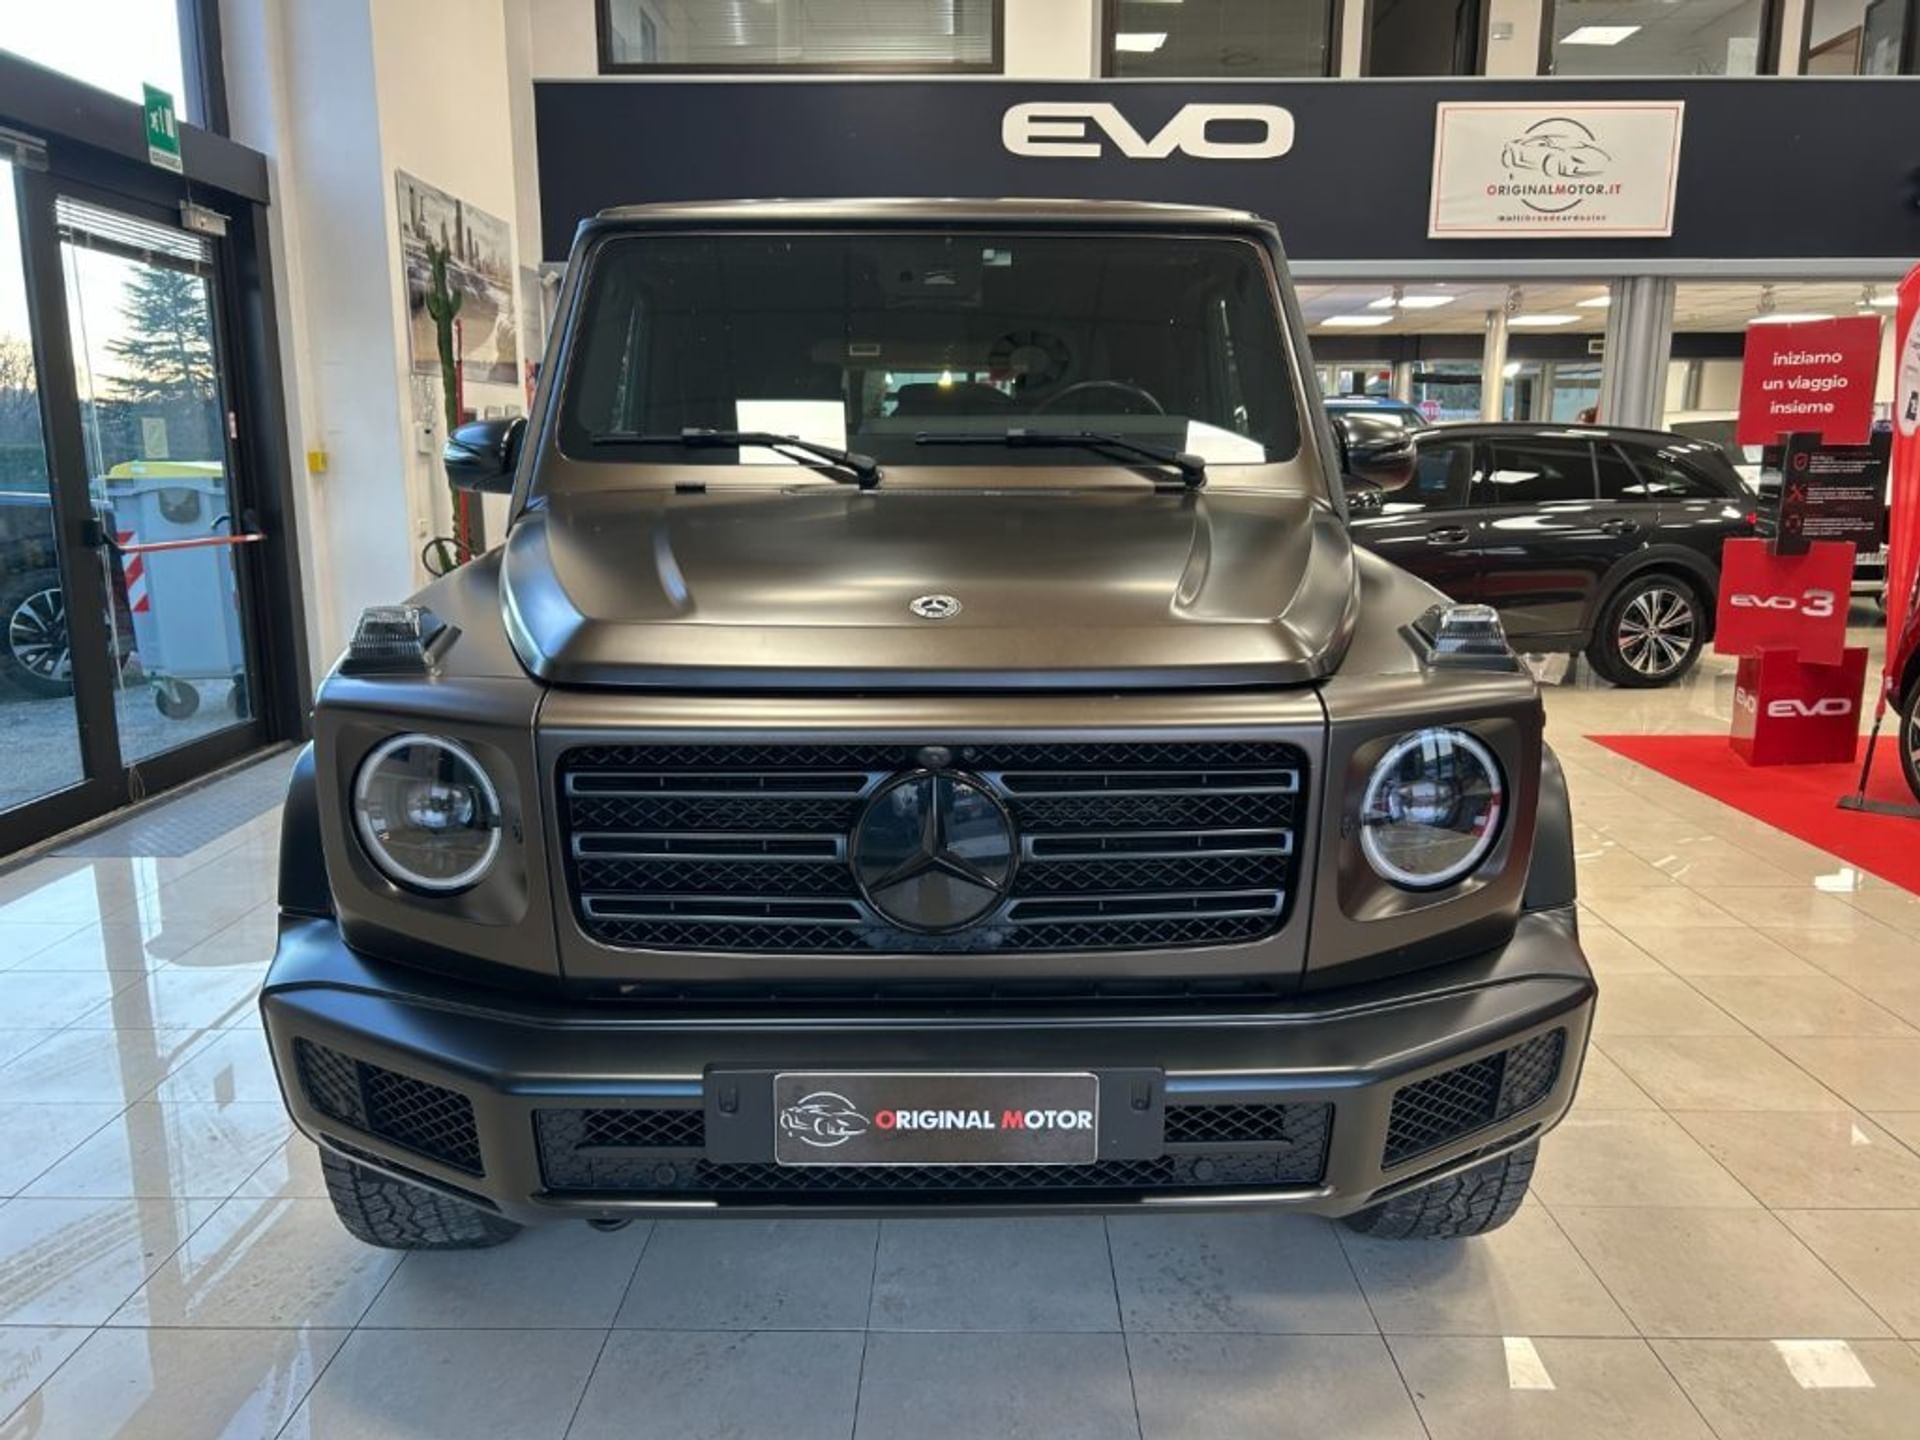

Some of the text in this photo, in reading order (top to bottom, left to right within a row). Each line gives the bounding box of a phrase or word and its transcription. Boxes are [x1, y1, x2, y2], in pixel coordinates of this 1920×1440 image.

[1002, 102, 1295, 159] EVO
[1486, 183, 1622, 196] ORIGINALMOTOR.IT
[1773, 351, 1843, 366] iniziamo
[1762, 375, 1848, 391] un viaggio
[1770, 400, 1835, 414] insieme
[1730, 589, 1834, 617] EVO 3
[1767, 698, 1852, 717] EVO
[875, 1110, 1093, 1129] ORIGINAL MOTOR
